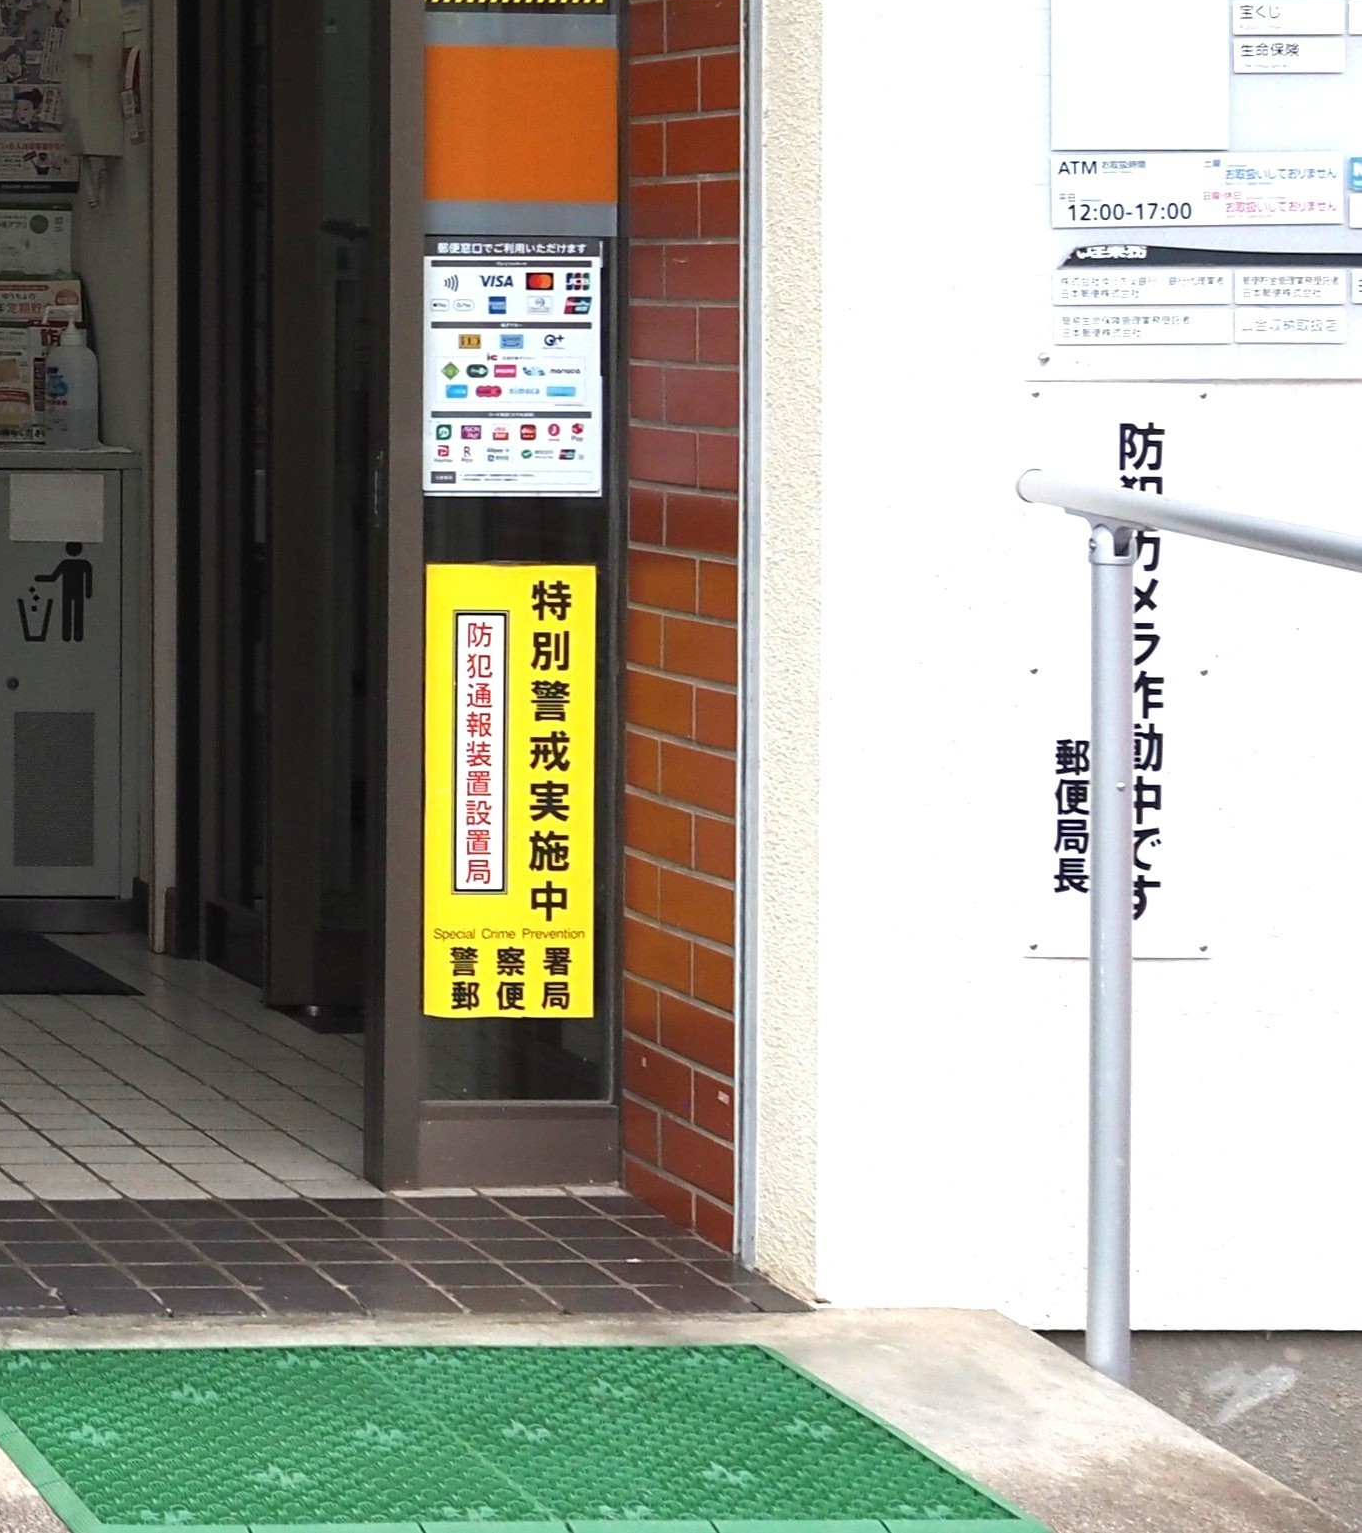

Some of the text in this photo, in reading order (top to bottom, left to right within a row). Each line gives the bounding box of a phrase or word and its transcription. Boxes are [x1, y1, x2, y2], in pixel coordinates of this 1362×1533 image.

[1058, 160, 1098, 175] ATM
[1068, 202, 1192, 221] 12:00-17:00
[436, 242, 588, 255] 郵便窓口でご利用いただけます
[478, 274, 514, 288] VISA
[464, 621, 494, 886] 防犯通報装置設置局
[528, 579, 573, 923] 特別警戒実施中
[1054, 738, 1091, 894] 郵便局長
[433, 927, 586, 941] Special Crime Prevention
[449, 946, 573, 977] 警察署
[450, 981, 570, 1011] 郵便局
